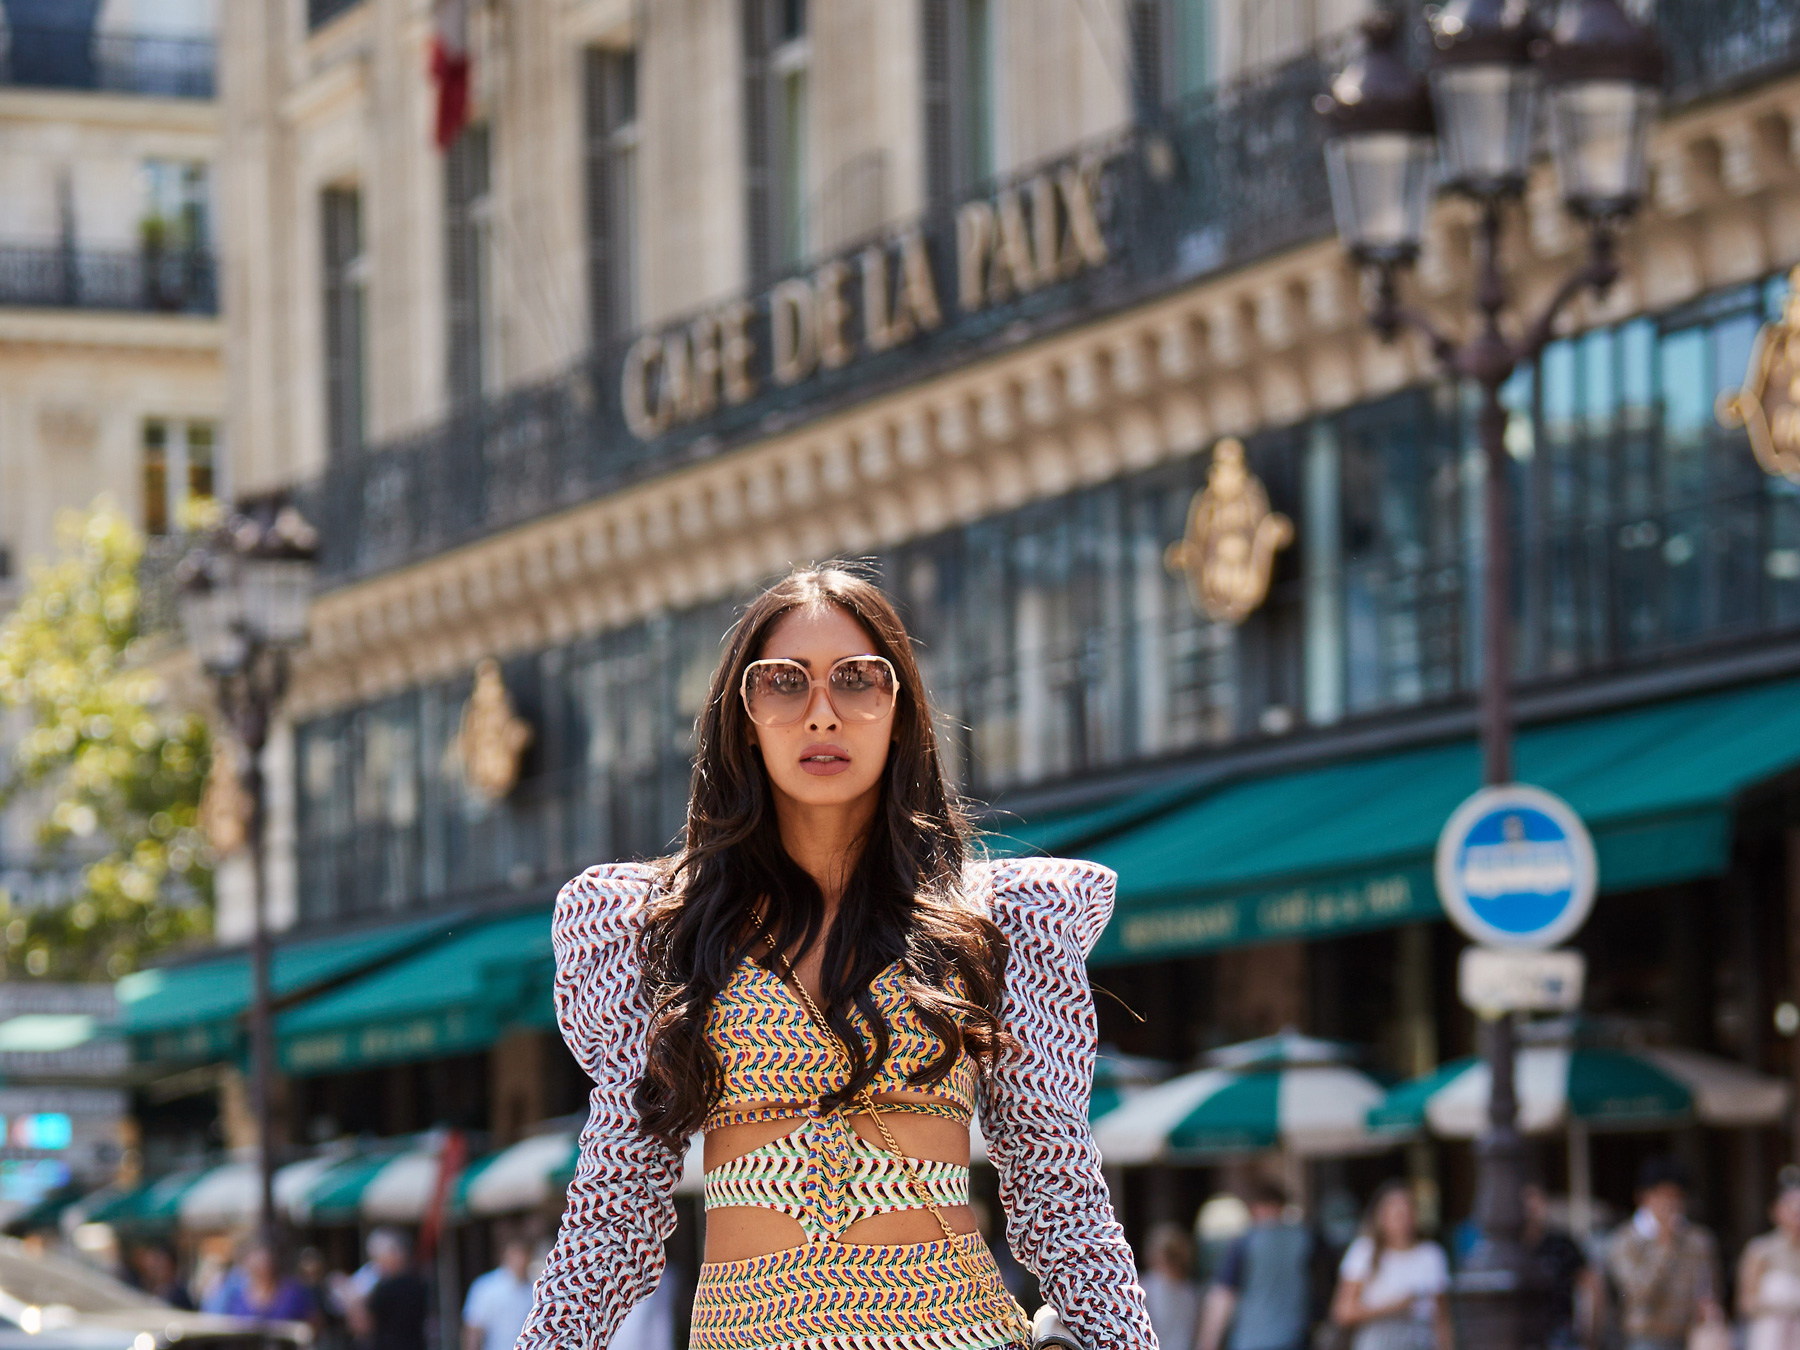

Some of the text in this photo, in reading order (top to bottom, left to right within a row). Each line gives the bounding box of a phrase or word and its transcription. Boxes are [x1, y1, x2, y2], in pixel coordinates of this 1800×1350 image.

[769, 263, 850, 387] DE
[859, 231, 941, 352] LA
[955, 155, 1108, 313] PAIX
